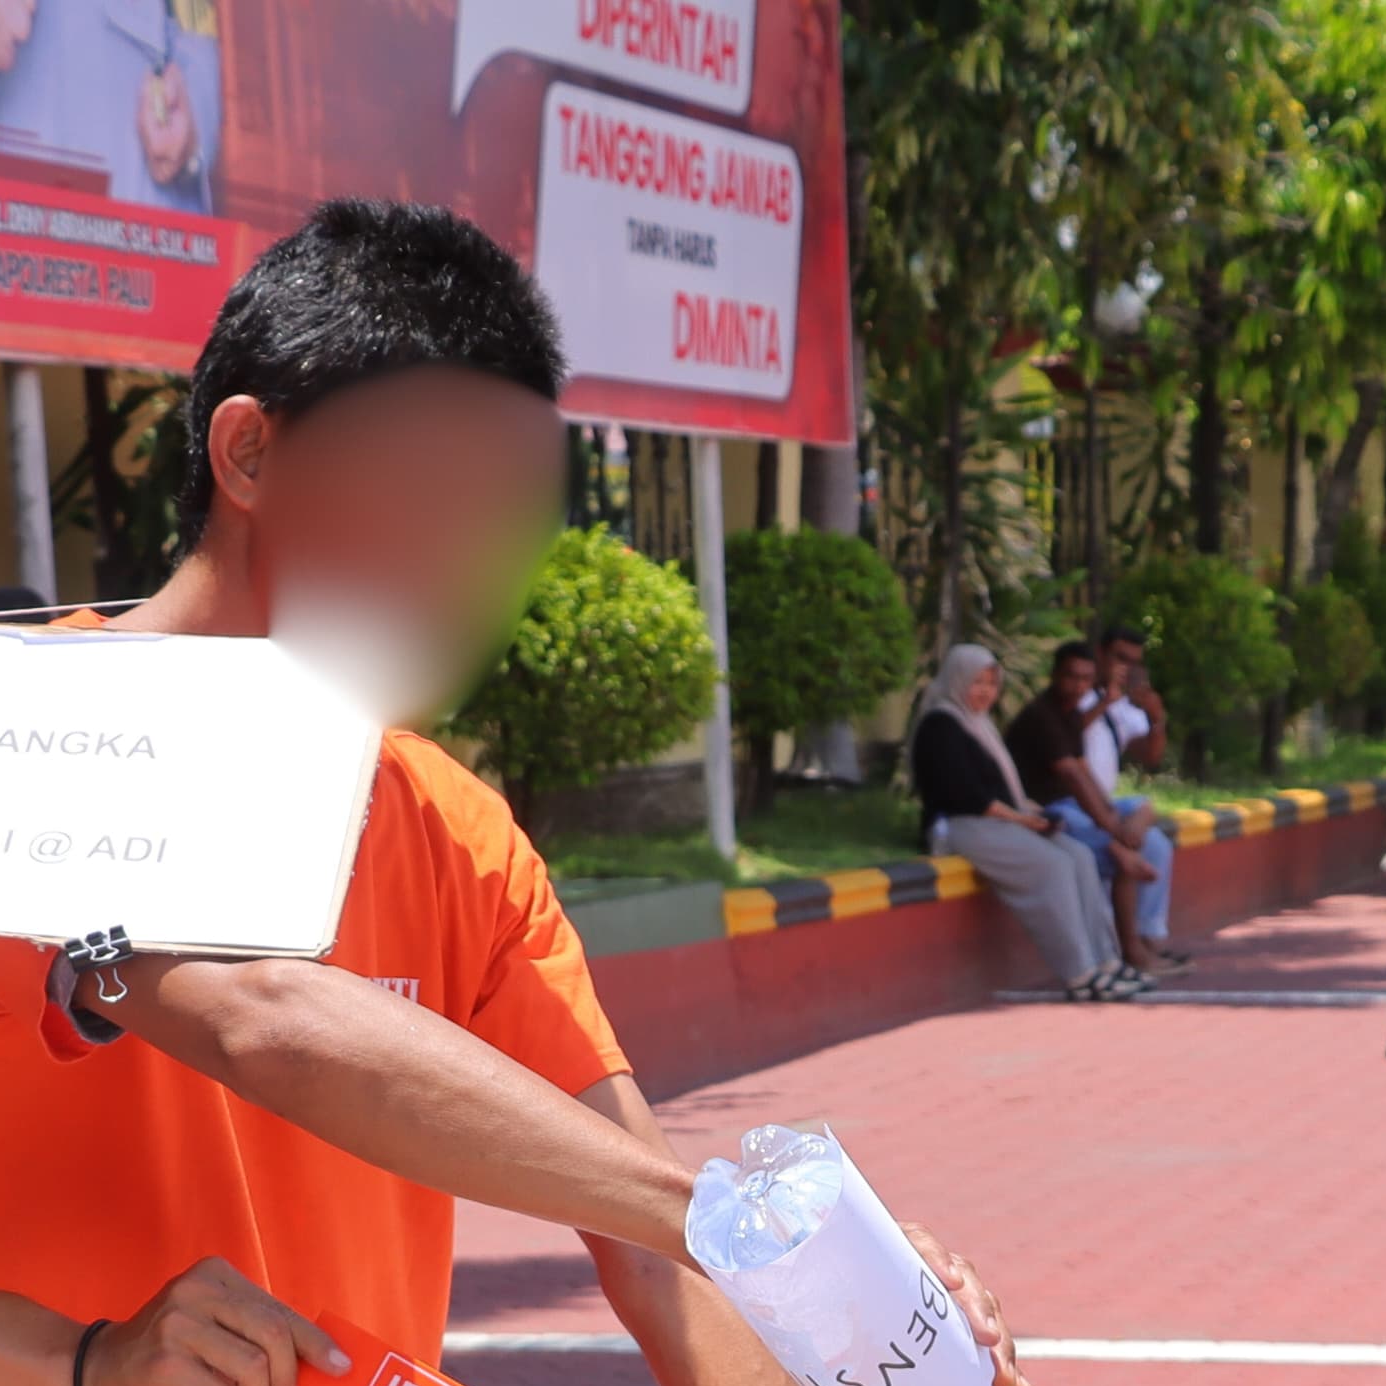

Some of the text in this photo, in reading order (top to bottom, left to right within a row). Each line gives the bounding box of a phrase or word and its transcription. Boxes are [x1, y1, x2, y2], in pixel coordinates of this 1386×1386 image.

[577, 0, 739, 86] DIPERINTAH
[559, 104, 793, 224] TANGGUNG JAWAB
[627, 216, 717, 269] TANPA HARUS
[107, 265, 153, 310] PALU
[673, 290, 782, 374] DIMINTA
[28, 830, 73, 863] @
[87, 834, 167, 863] ADI
